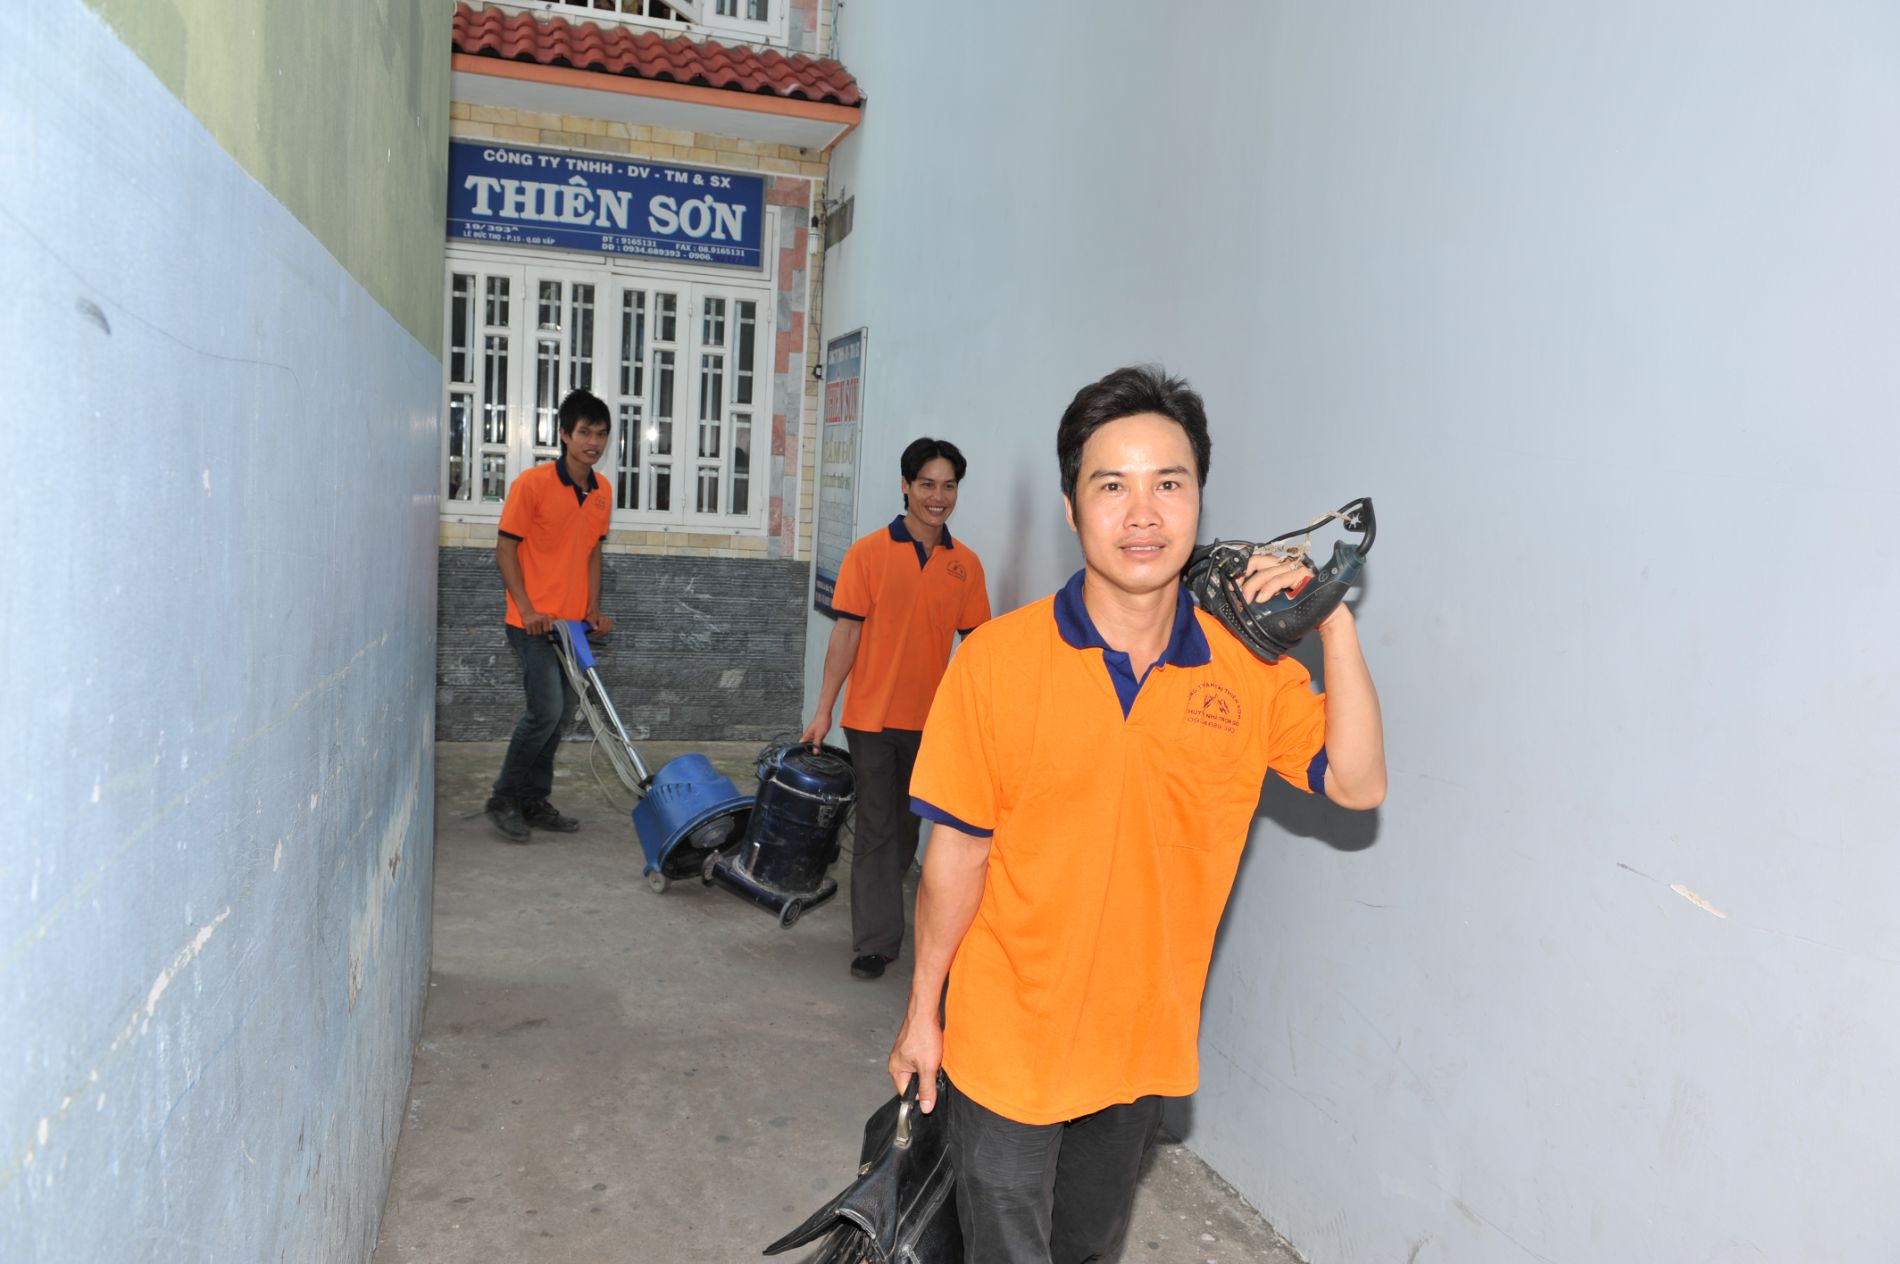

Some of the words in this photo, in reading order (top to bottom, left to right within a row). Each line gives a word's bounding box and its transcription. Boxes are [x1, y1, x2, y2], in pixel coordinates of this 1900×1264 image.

[483, 148, 533, 166] CÔNG
[538, 155, 560, 168] TY
[566, 158, 613, 174] TNHH
[628, 165, 650, 178] DV
[664, 170, 688, 184] TM
[692, 174, 705, 186] &
[710, 175, 731, 189] SX
[464, 174, 632, 229] THIÊN
[648, 194, 747, 241] SƠN
[675, 242, 691, 251] FAX
